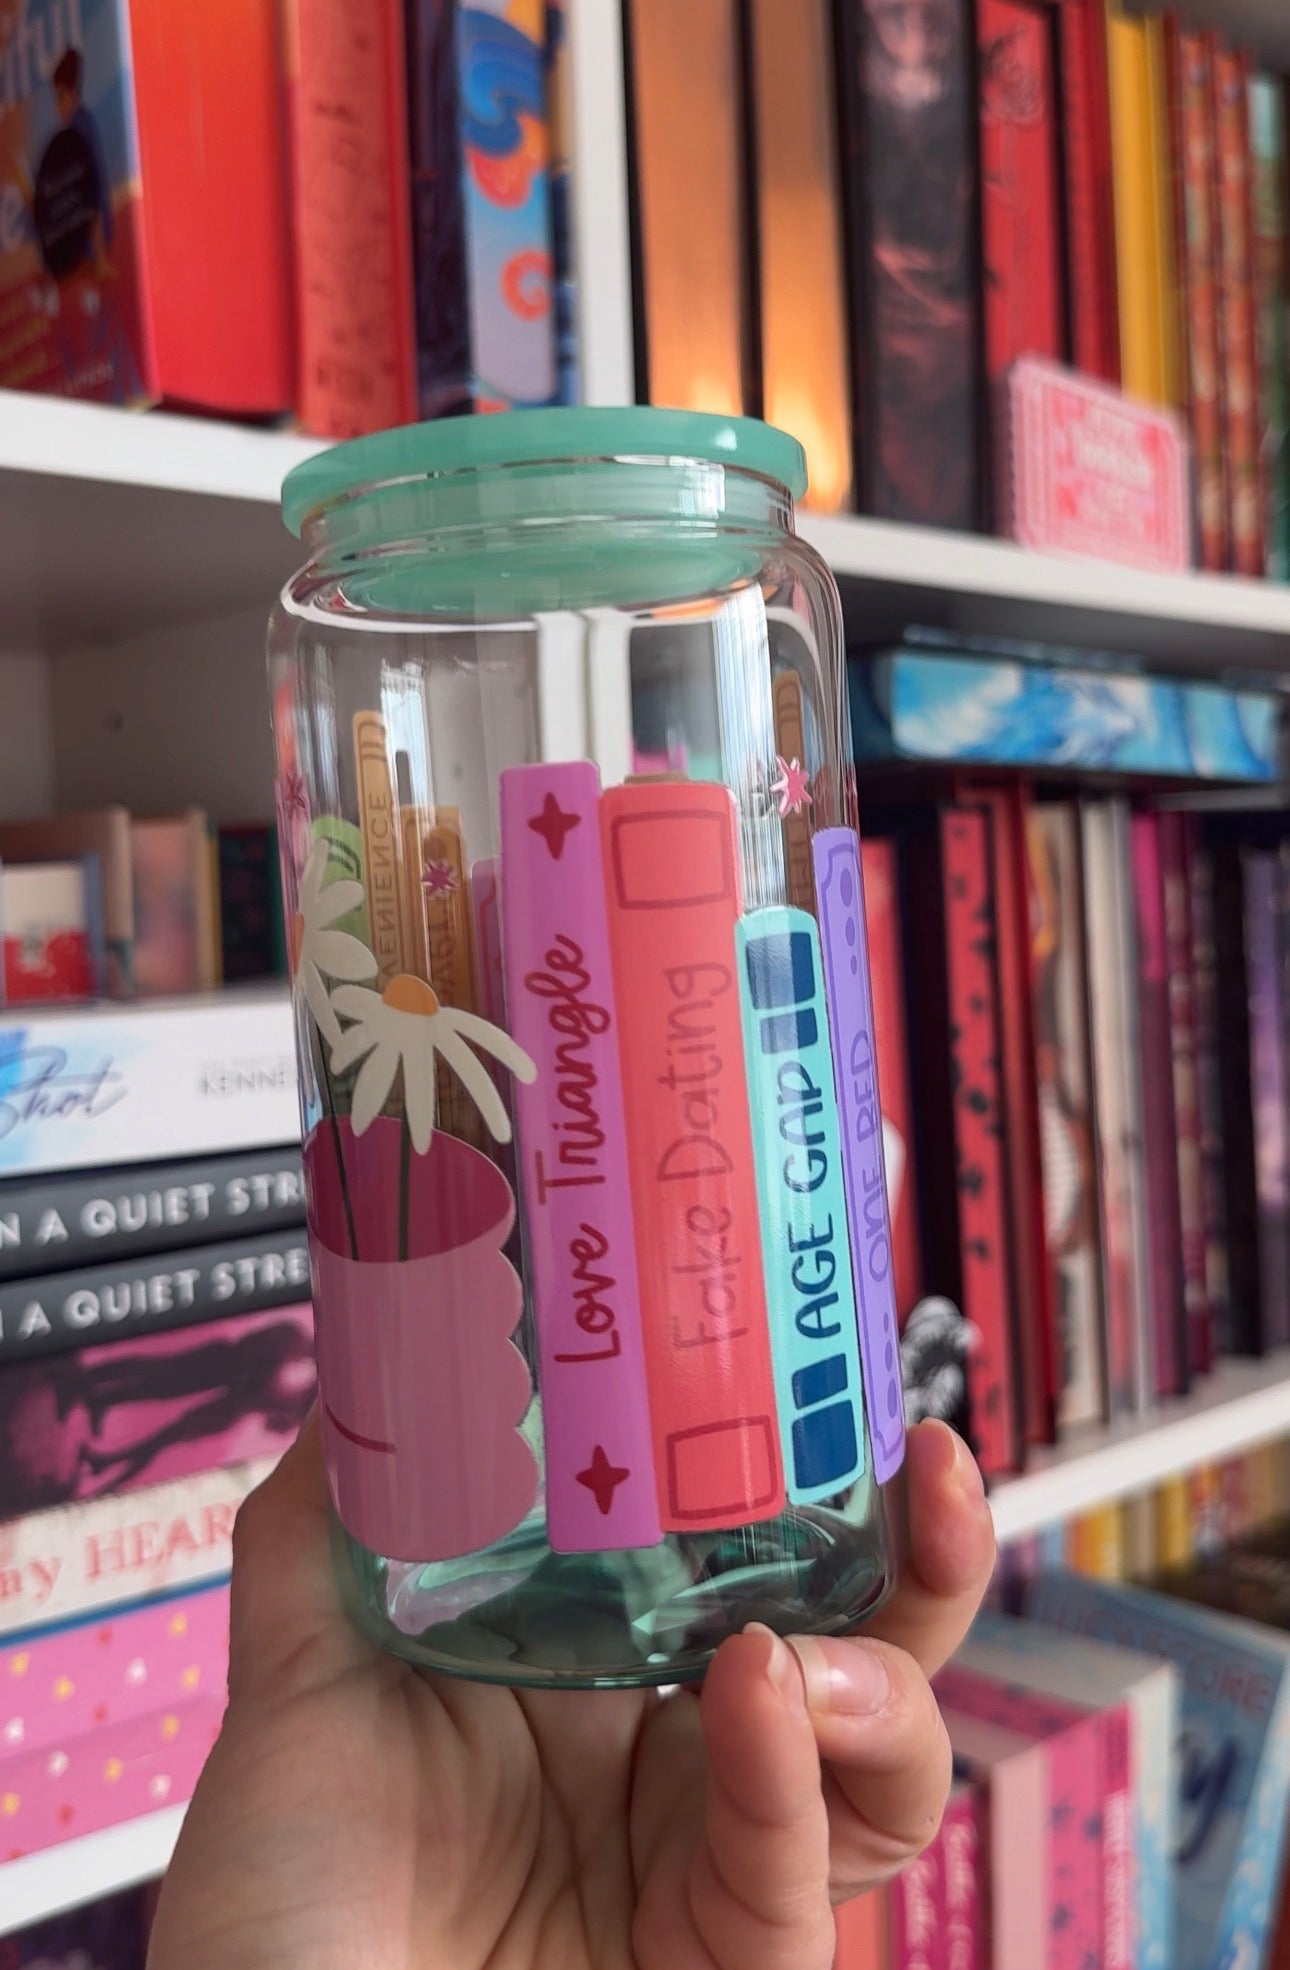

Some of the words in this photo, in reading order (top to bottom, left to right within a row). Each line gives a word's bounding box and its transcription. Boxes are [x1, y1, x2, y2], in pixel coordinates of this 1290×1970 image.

[523, 933, 612, 1206] Triangle
[656, 960, 735, 1183] Dating
[776, 1060, 829, 1195] GAP
[849, 1028, 878, 1145] BED
[34, 1207, 69, 1246] A
[79, 1181, 216, 1238] QUIET
[224, 1170, 306, 1218] STR
[861, 1166, 892, 1284] ONE
[18, 1300, 51, 1340] A
[62, 1267, 201, 1330] QUIET
[210, 1246, 309, 1301] STRE
[553, 1222, 622, 1365] Love
[671, 1204, 750, 1350] Fake
[787, 1212, 843, 1340] AGE
